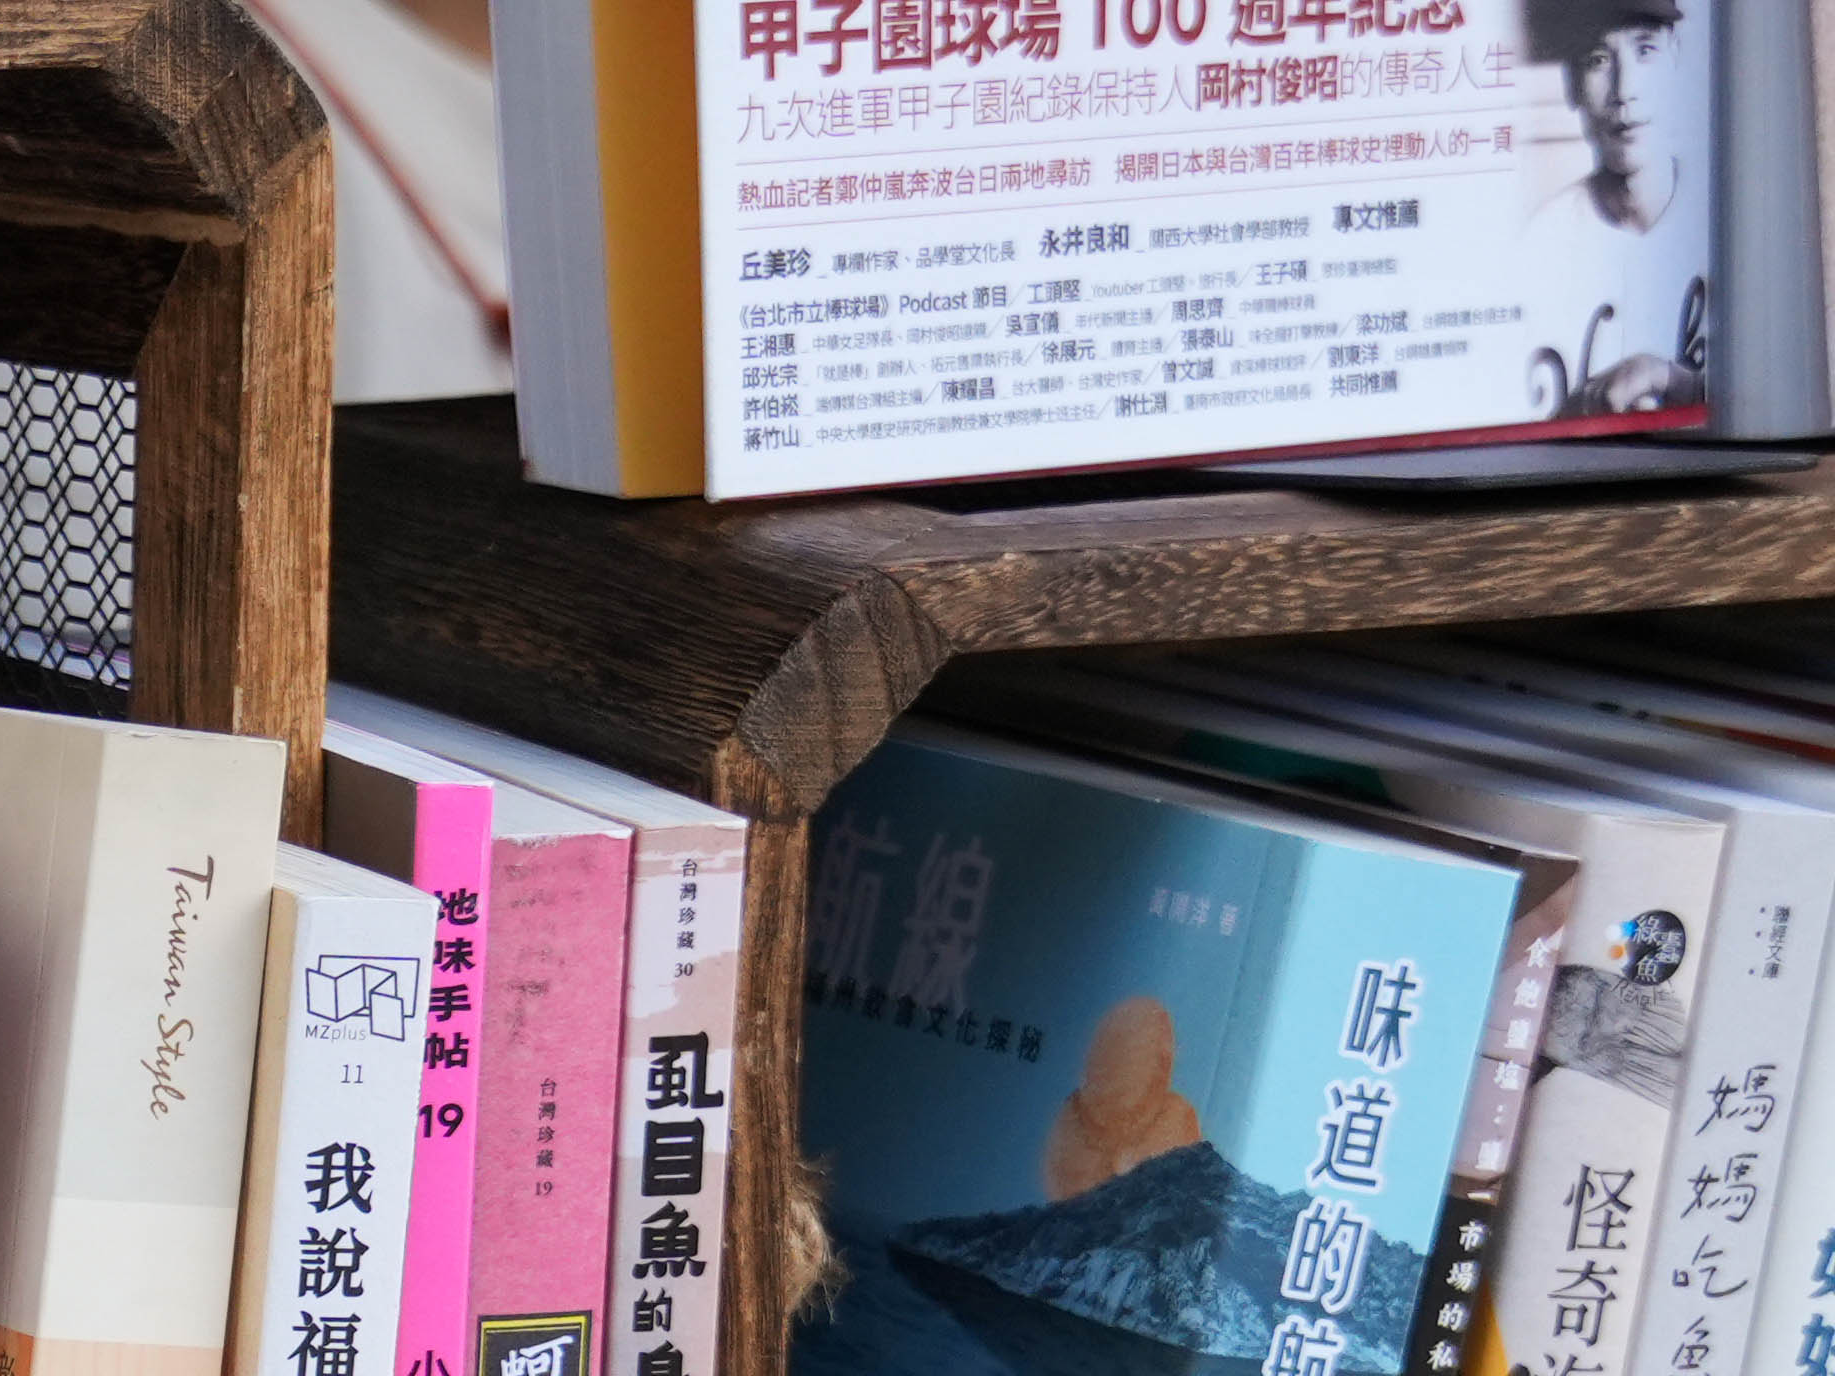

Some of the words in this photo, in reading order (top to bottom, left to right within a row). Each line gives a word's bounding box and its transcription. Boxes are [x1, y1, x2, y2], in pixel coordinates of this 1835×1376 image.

[739, 248, 812, 281] 丘美珍
[1039, 224, 1130, 258] 永井良和
[1332, 199, 1419, 234] 專文推薦
[899, 292, 967, 315] Podcast
[676, 858, 698, 950] 台灣珍藏
[163, 855, 215, 1007] Taiwan
[424, 888, 479, 1071] 地味手帖
[673, 961, 694, 979] 30
[305, 1023, 368, 1042] MZplus
[140, 1013, 195, 1121] Style
[340, 1065, 364, 1084] 11
[418, 1102, 464, 1139] 19
[534, 1180, 553, 1196] 19
